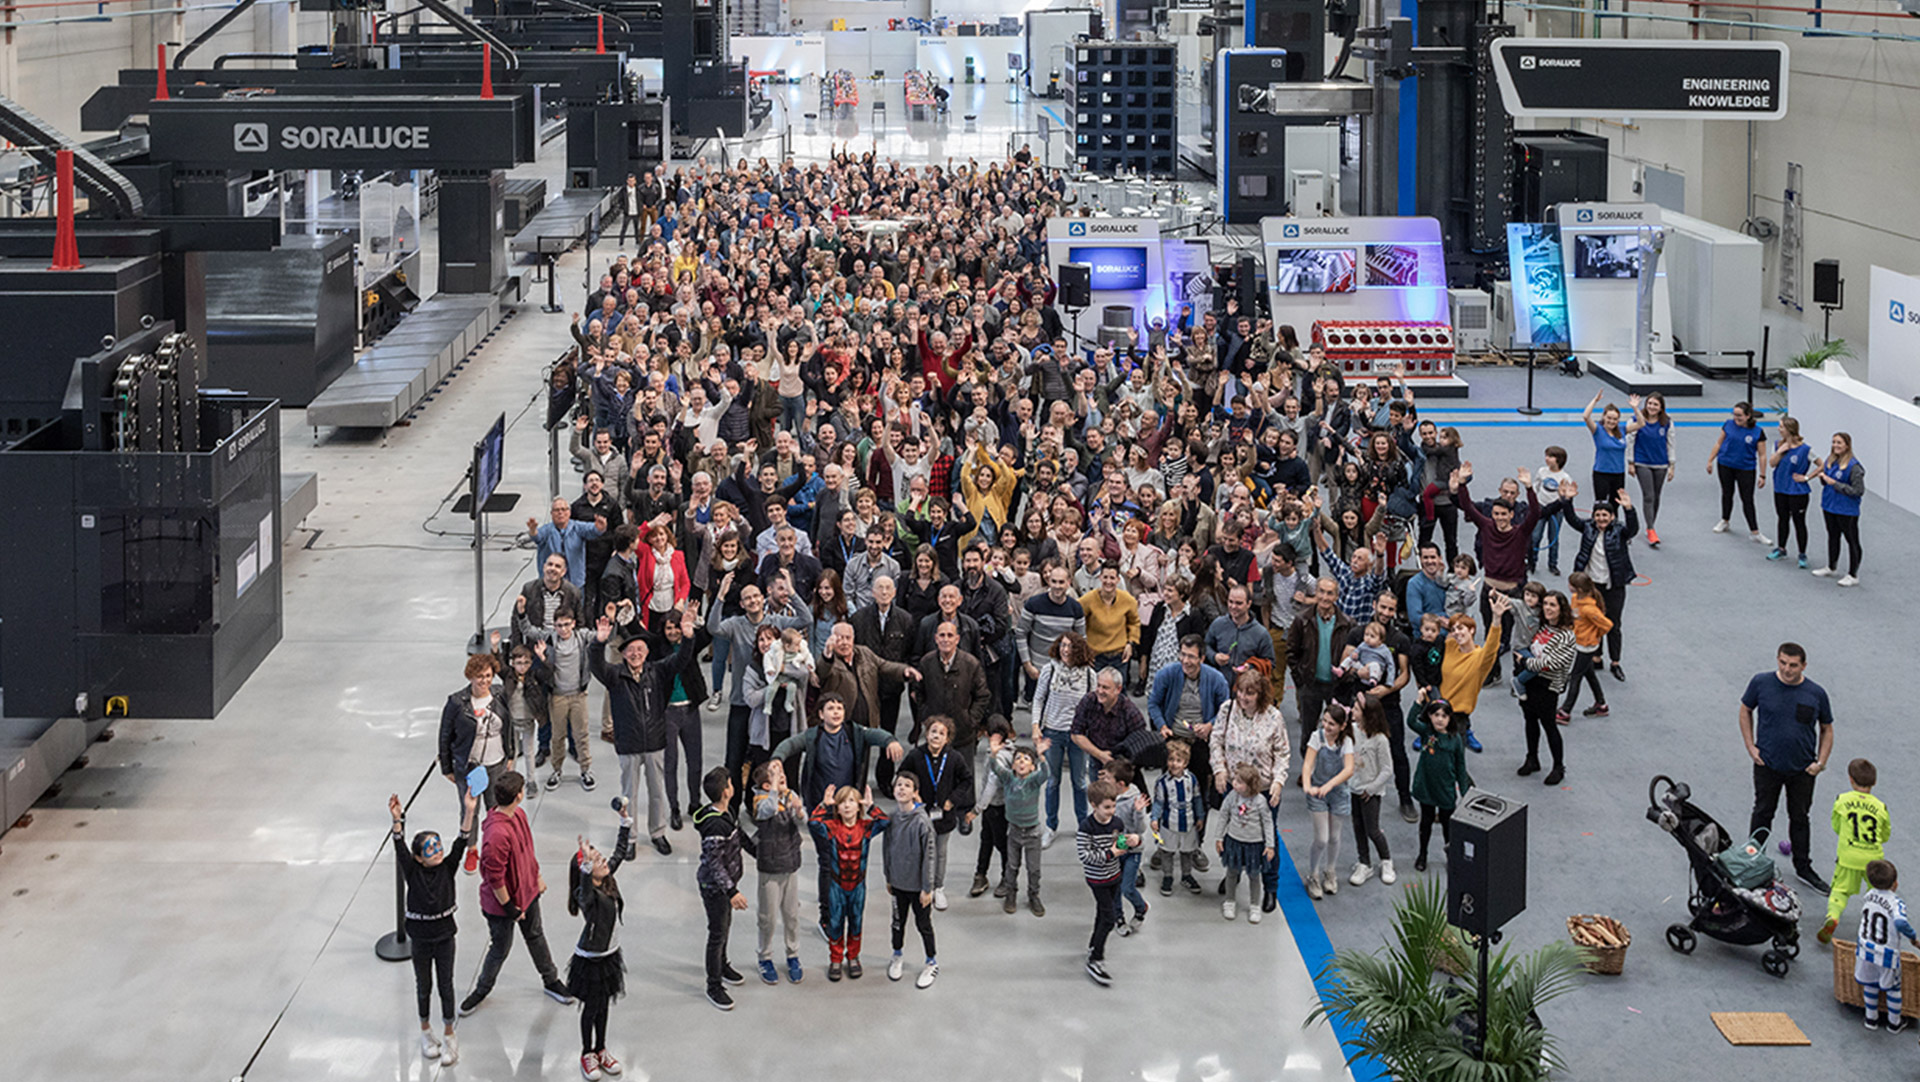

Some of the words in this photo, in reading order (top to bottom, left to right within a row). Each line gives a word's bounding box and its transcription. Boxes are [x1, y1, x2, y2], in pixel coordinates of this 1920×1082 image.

[1539, 58, 1581, 67] SORALUCE
[1682, 78, 1770, 91] ENGINEERING
[1688, 95, 1770, 107] KNOWLEDGE
[281, 126, 430, 149] SORALUCE
[1597, 211, 1643, 220] SORALUCE
[1090, 224, 1138, 233] SORALUCE
[1304, 227, 1349, 235] SORALUCE
[1096, 265, 1139, 273] SORALUCE
[1848, 812, 1877, 843] 13
[1862, 907, 1888, 945] 10
